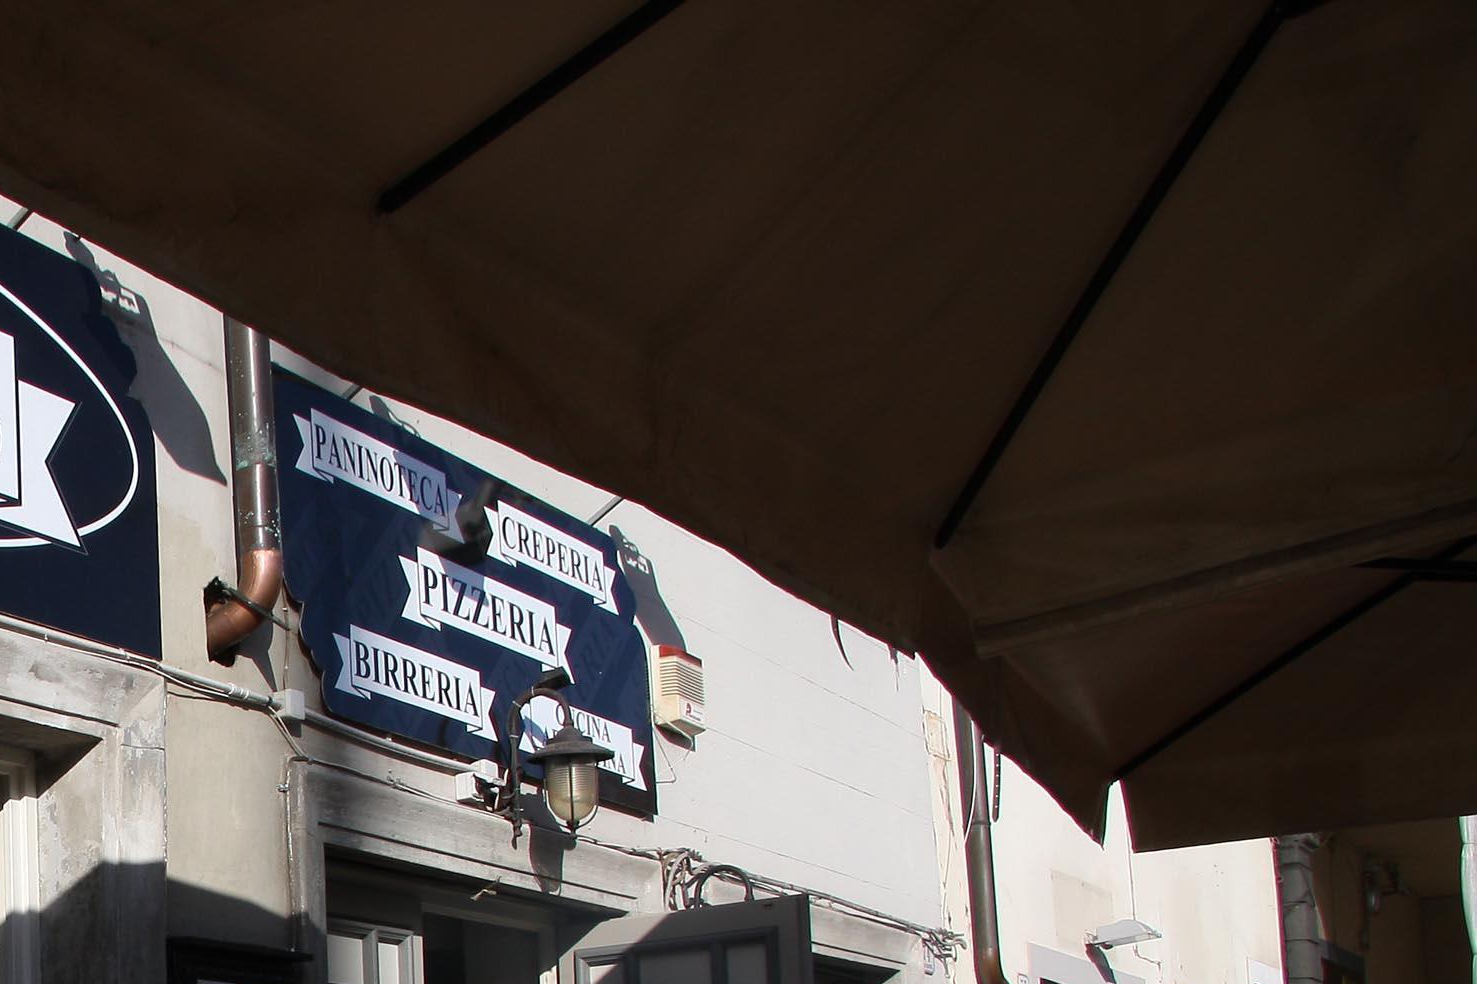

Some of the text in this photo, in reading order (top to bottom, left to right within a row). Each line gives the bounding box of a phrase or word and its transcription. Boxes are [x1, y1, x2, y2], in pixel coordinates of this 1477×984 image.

[314, 424, 448, 517] PANINOTECA
[501, 515, 604, 592] CREPERIA
[423, 566, 556, 657] PIZZERIA
[354, 641, 480, 718] BIRRERIA
[555, 703, 612, 744] CCINA
